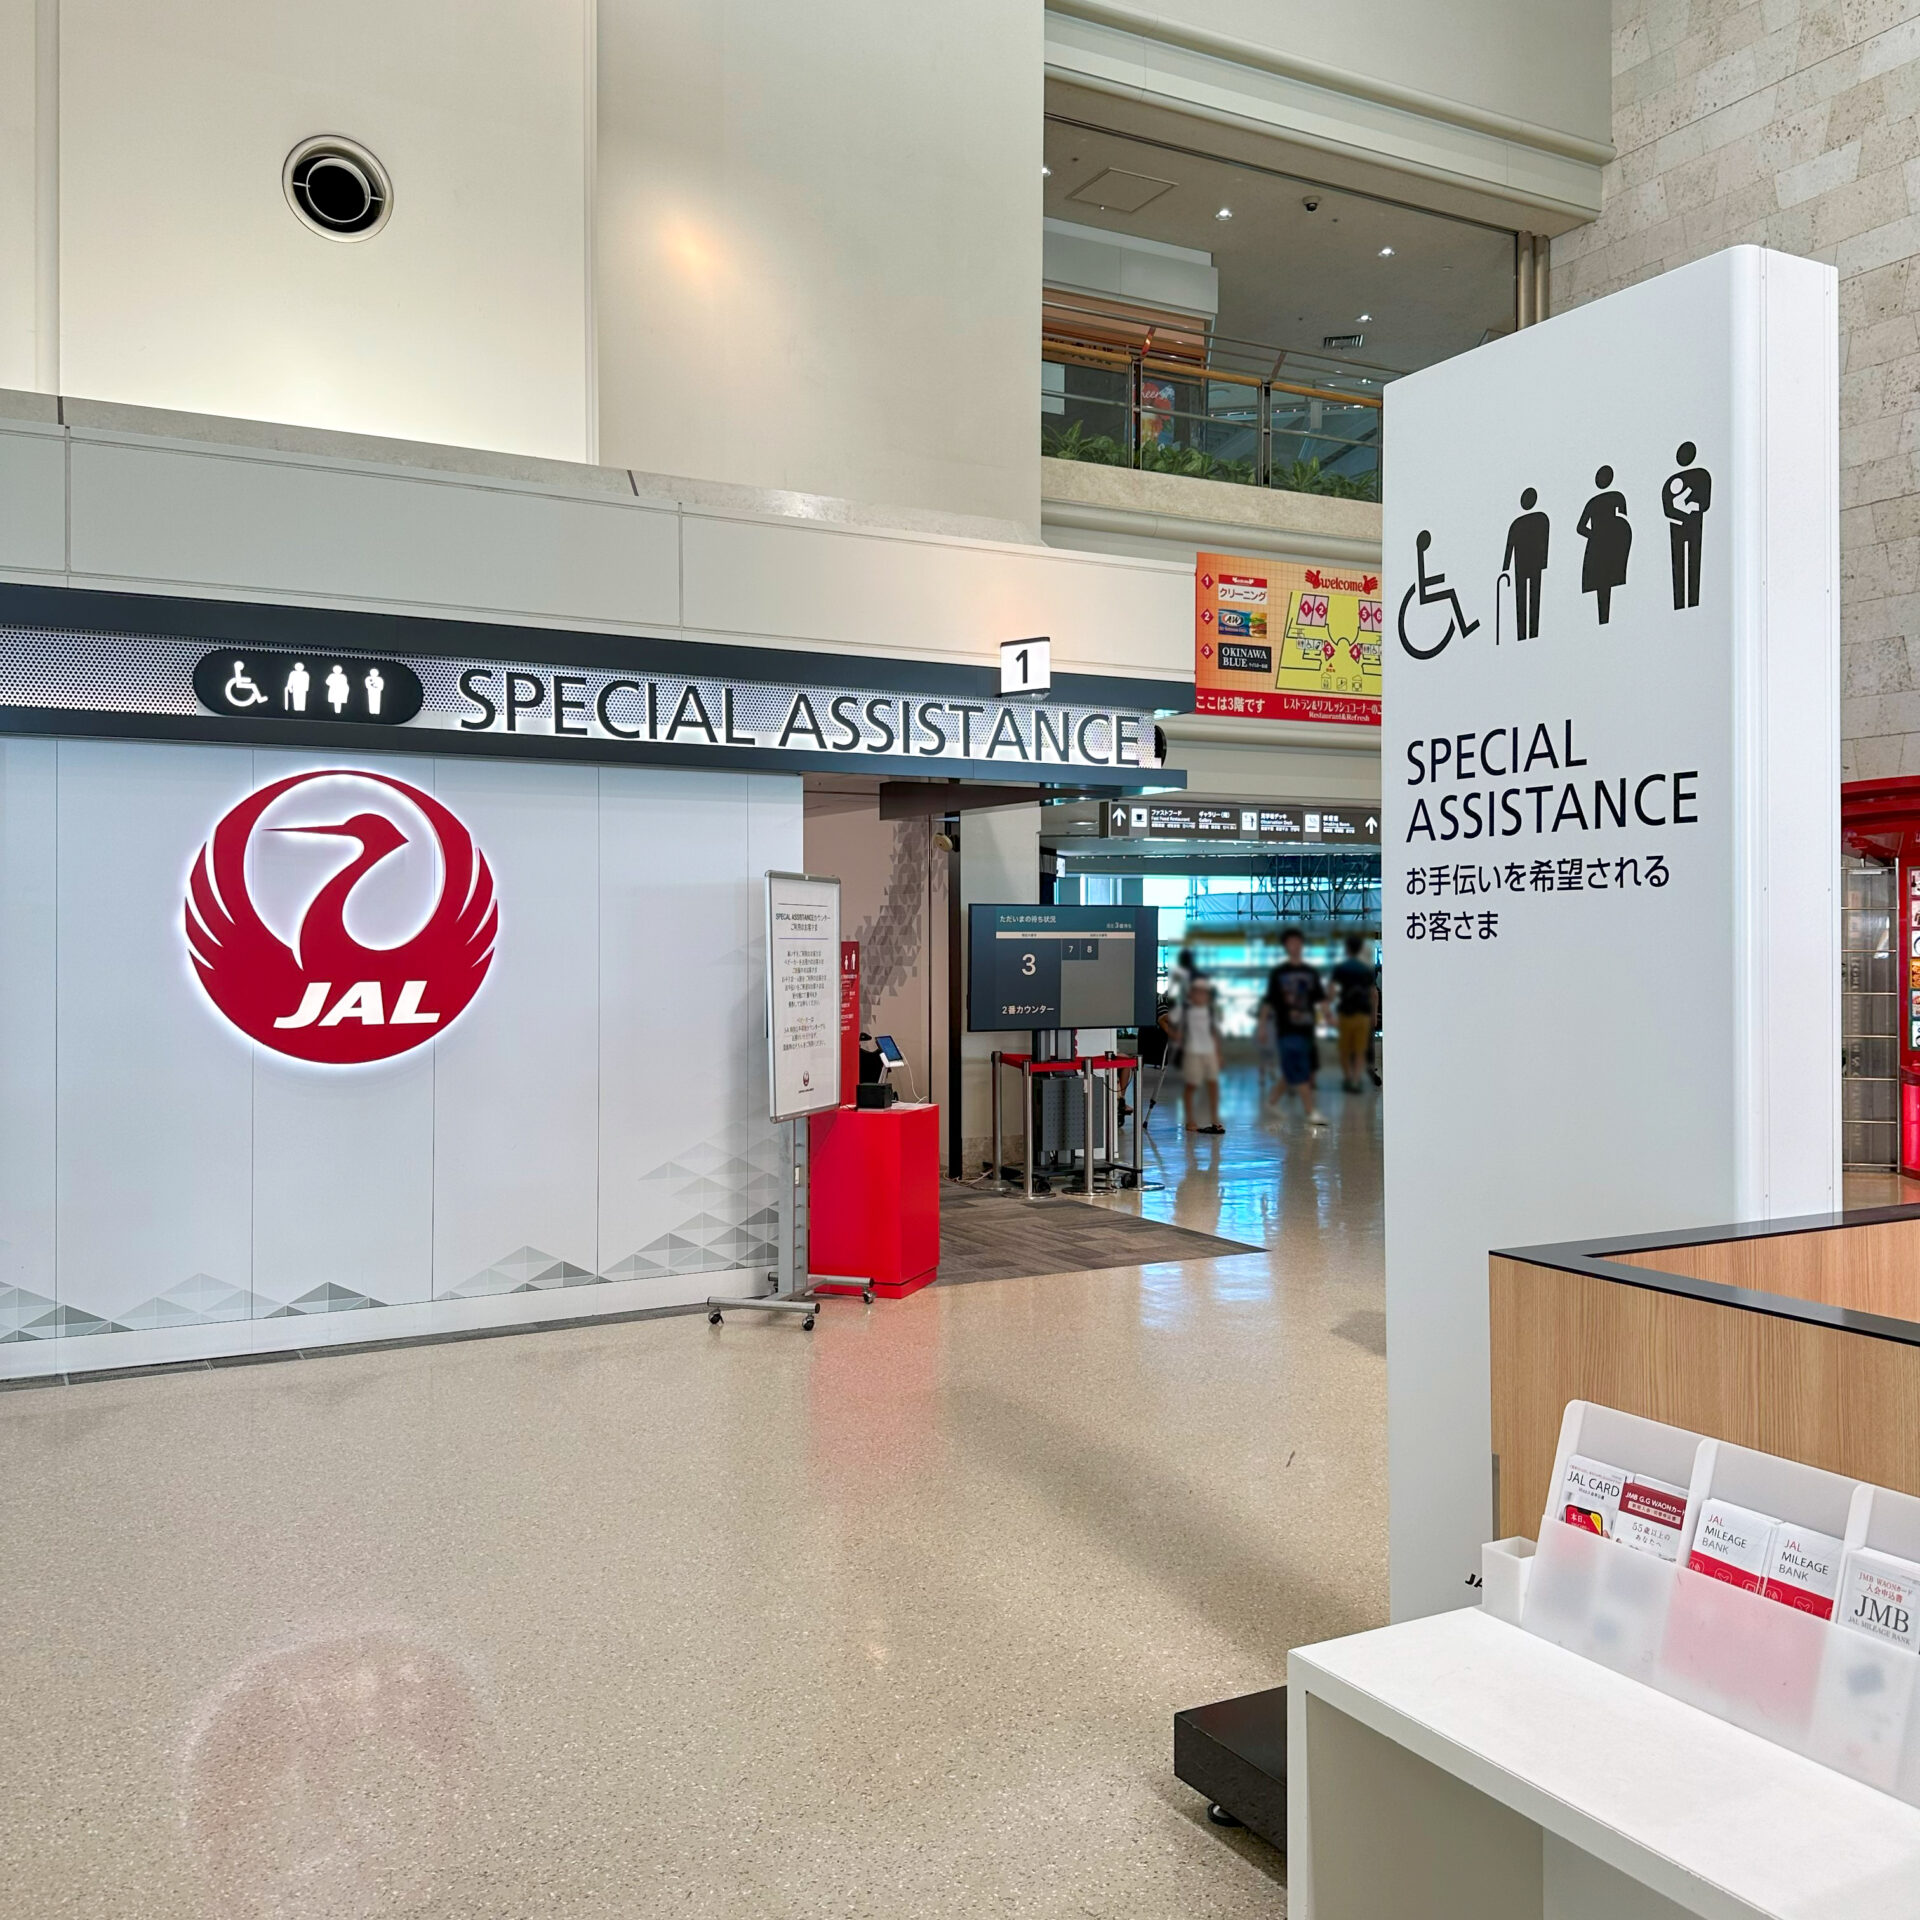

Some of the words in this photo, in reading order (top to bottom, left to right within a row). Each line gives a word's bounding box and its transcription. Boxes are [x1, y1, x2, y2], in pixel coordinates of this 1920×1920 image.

[1205, 576, 1209, 585] 1
[1321, 577, 1364, 592] welcome
[1219, 587, 1267, 602] クリーニング
[1204, 612, 1210, 620] 2
[1304, 604, 1308, 613] 1
[1318, 606, 1324, 615] 2
[1361, 609, 1367, 619] 5
[1376, 611, 1382, 620] 6
[1204, 646, 1210, 655] 3
[1221, 646, 1267, 659] OKINAWA
[1326, 645, 1331, 654] 3
[1352, 647, 1358, 656] 4
[1015, 649, 1029, 684] 1
[1222, 656, 1248, 668] BLUE
[1196, 695, 1265, 713] ここは3階です
[459, 668, 756, 746] SPECIAL
[778, 693, 1140, 767] ASSISTANCE
[1407, 719, 1587, 786] SPECIAL
[1406, 771, 1699, 843] ASSISTANCE
[1406, 854, 1670, 896] お手伝いを希望される
[1000, 915, 1057, 924] ただいまの待ち状況
[1406, 910, 1499, 942] お客さま
[1068, 945, 1074, 953] 7
[1086, 945, 1092, 953] 8
[1021, 953, 1037, 976] 3
[273, 980, 441, 1029] JAL
[1002, 1004, 1055, 1015] 2番カウンター
[1567, 1471, 1586, 1487] JAL
[1588, 1478, 1620, 1497] CARD
[1625, 1491, 1639, 1501] JMB
[1708, 1513, 1724, 1528] JAL
[1632, 1522, 1671, 1541] 55歳以上の
[1704, 1525, 1748, 1549] MILEAGE
[1702, 1537, 1729, 1555] BANK
[1784, 1539, 1802, 1553] JAL
[1781, 1551, 1829, 1576] MILEAGE
[1464, 1573, 1482, 1588] JA
[1779, 1564, 1809, 1582] BANK
[1859, 1571, 1874, 1583] JMB
[1866, 1583, 1903, 1603] 入会申込書
[1854, 1594, 1909, 1633] JMB
[1861, 1620, 1891, 1638] MILEAGE
